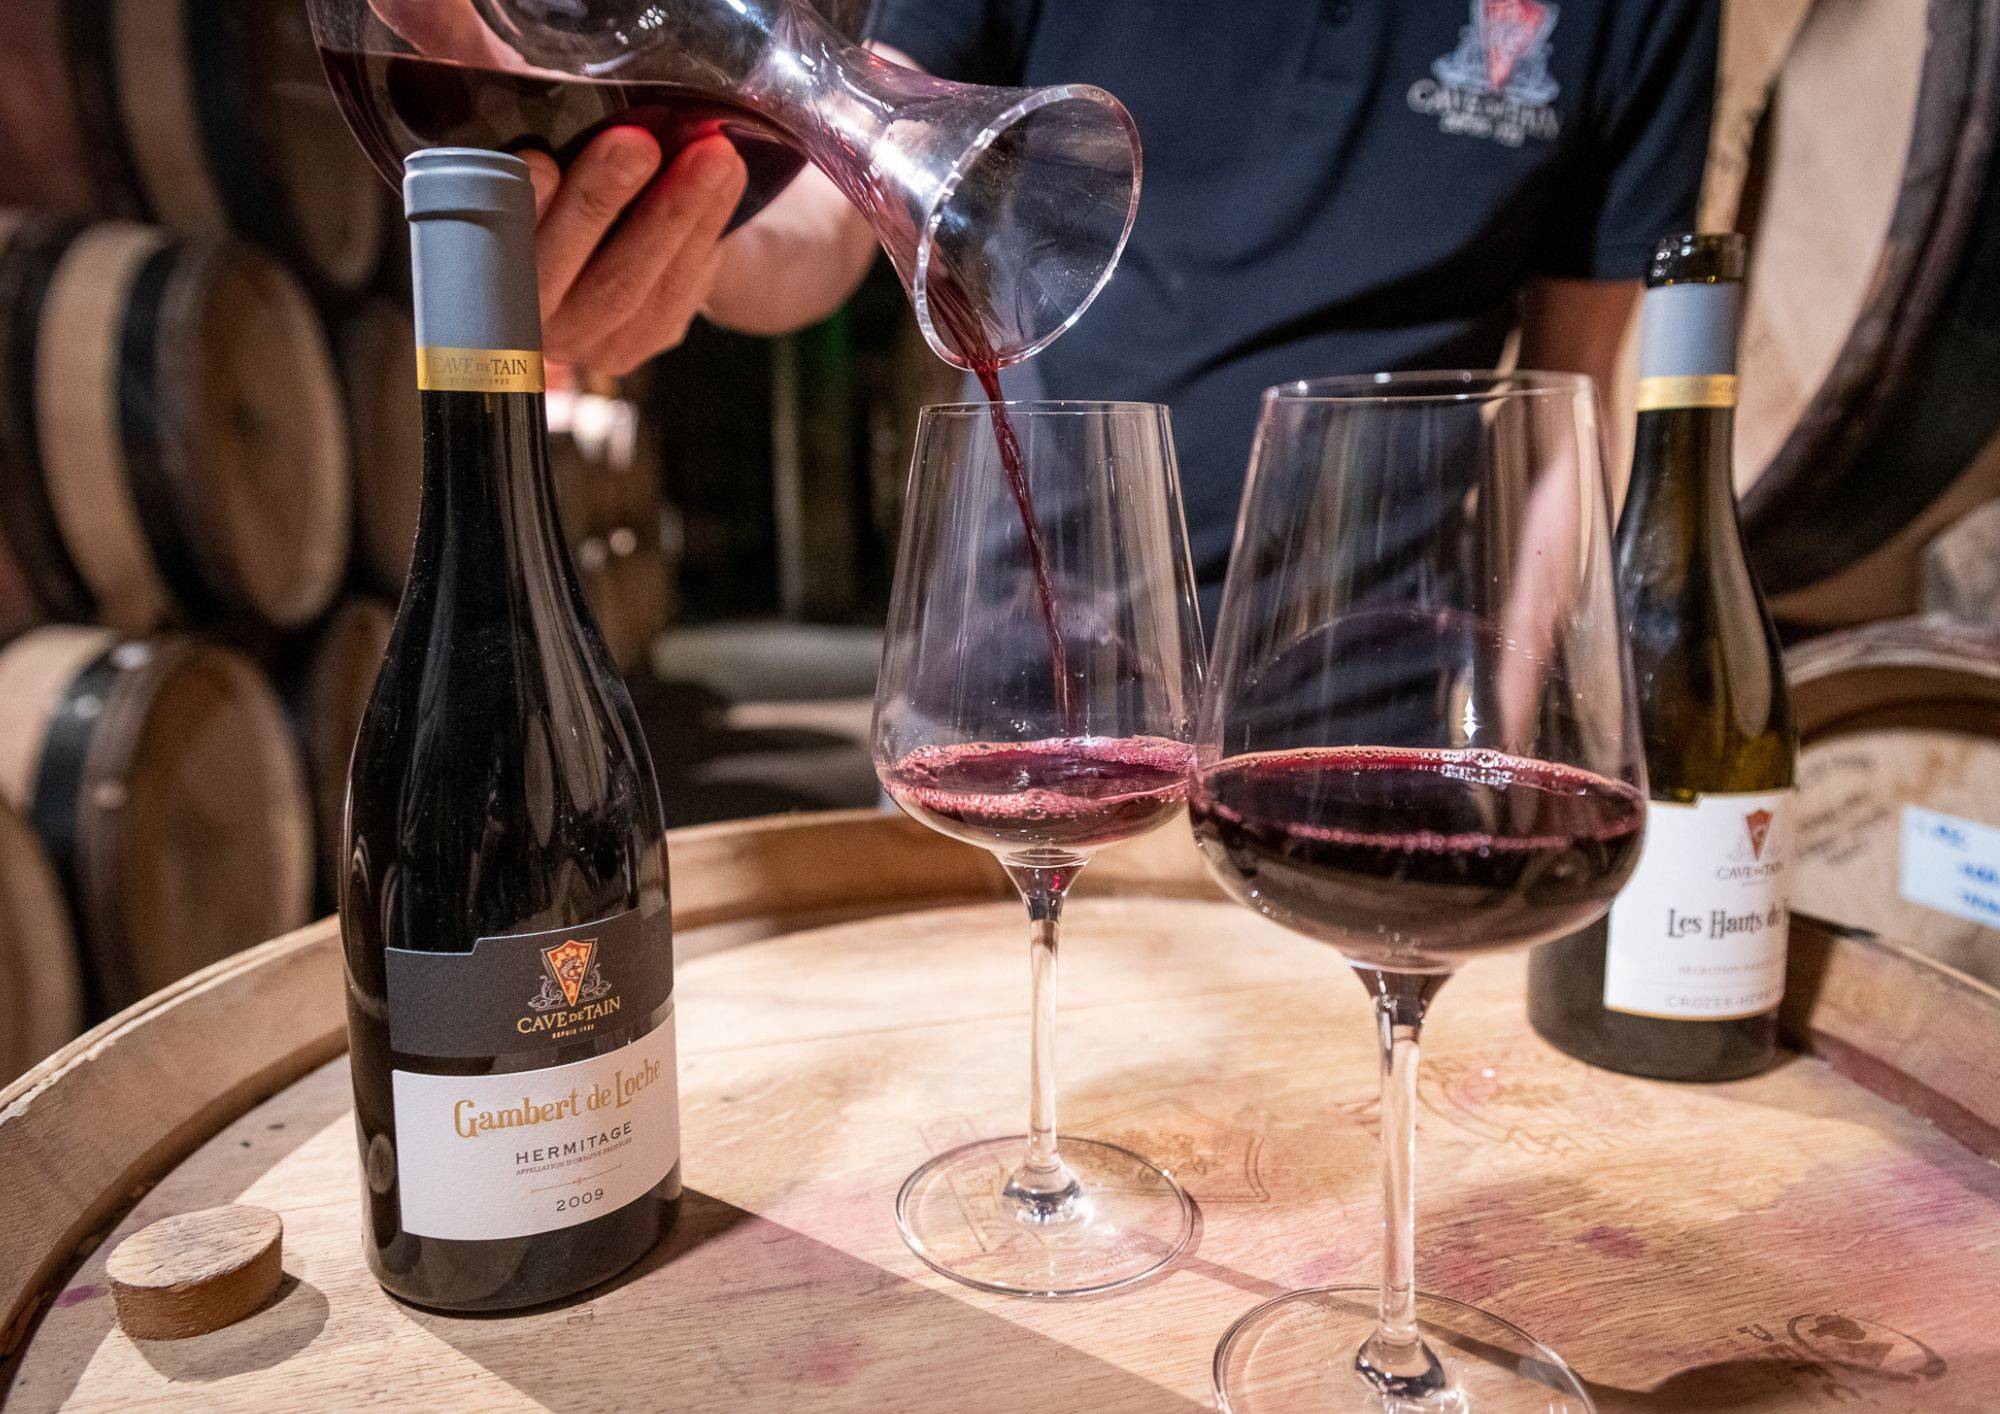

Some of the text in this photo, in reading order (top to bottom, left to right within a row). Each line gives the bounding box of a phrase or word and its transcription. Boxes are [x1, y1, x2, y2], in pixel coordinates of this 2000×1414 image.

[490, 358, 528, 375] TAIN
[1667, 908, 1702, 938] Les
[1709, 909, 1763, 939] Hauts
[516, 996, 621, 1034] CAVE DE TAIN
[454, 1057, 661, 1139] Gambert de Loche
[516, 1121, 632, 1165] HERMITAGE
[516, 1160, 565, 1176] APPELLATION
[556, 1187, 604, 1212] 2009
